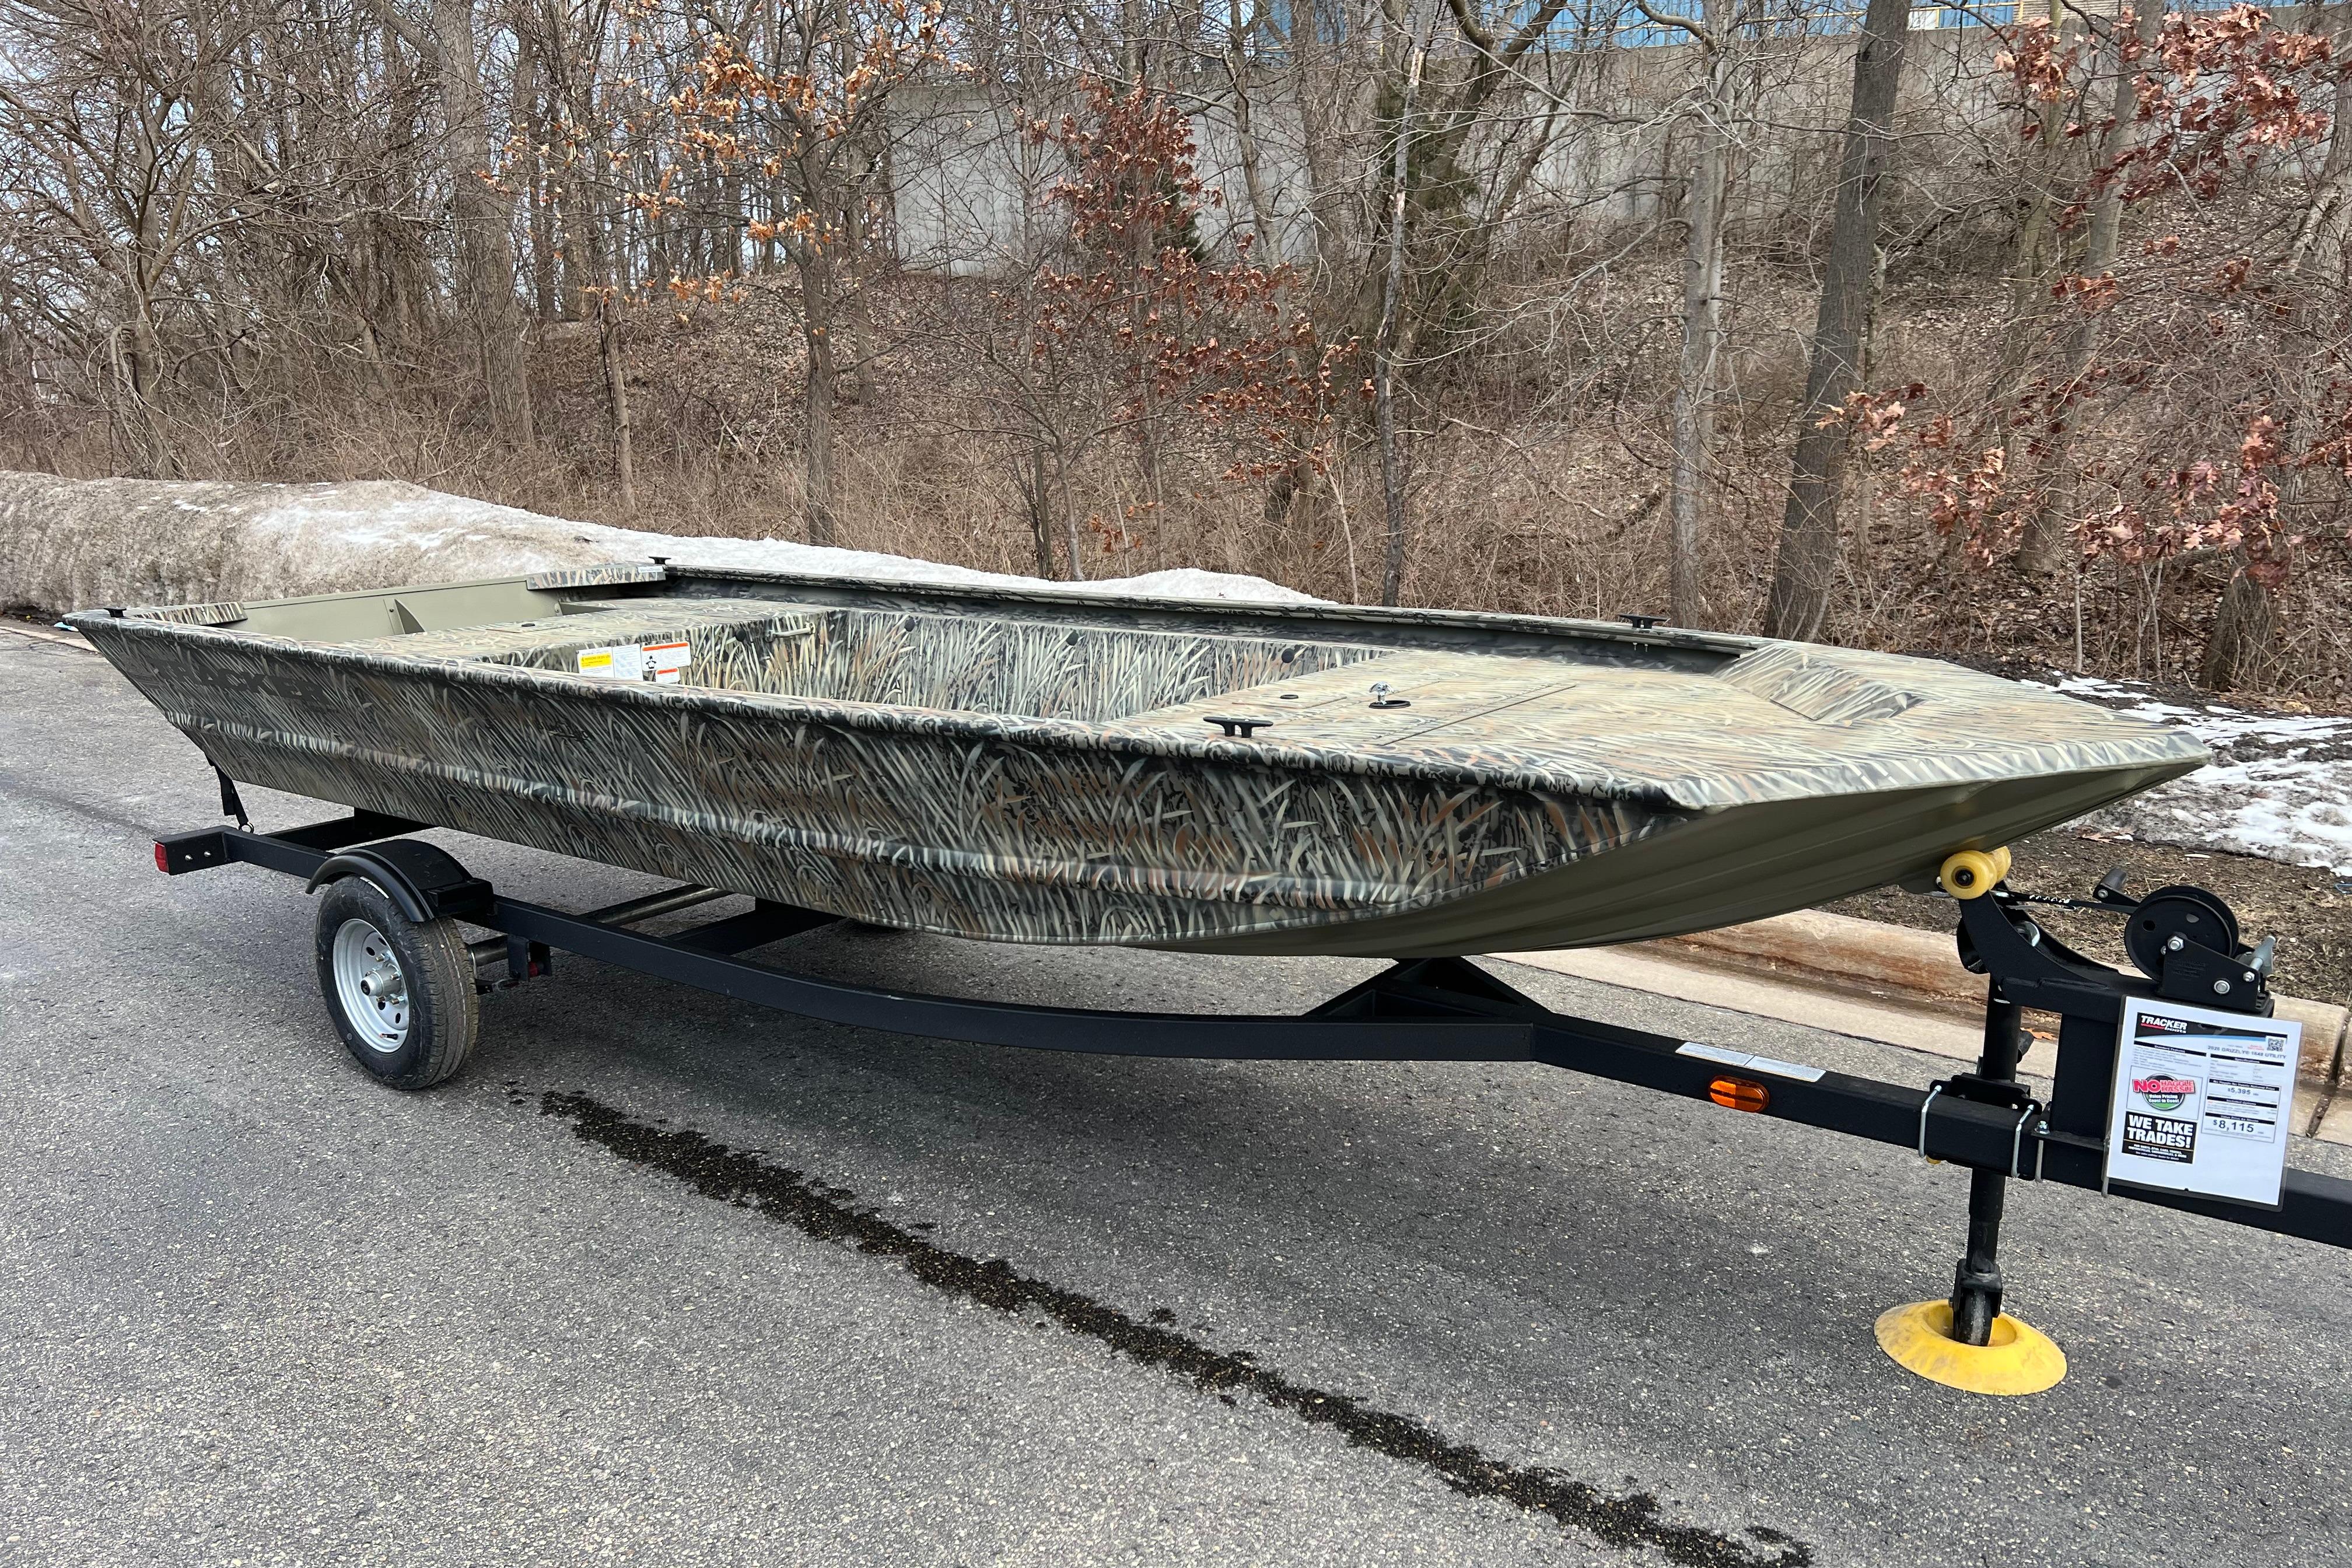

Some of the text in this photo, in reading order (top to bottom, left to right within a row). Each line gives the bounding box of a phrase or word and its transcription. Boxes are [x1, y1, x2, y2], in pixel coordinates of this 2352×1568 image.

[146, 657, 331, 704] TRACKER
[2141, 1015, 2188, 1030] TRACKER
[2133, 1079, 2161, 1093] NO
[2129, 1114, 2152, 1130] WE
[2155, 1119, 2193, 1136] TAKE
[2213, 1119, 2254, 1132] $8,115
[2127, 1126, 2191, 1148] TRADES!
